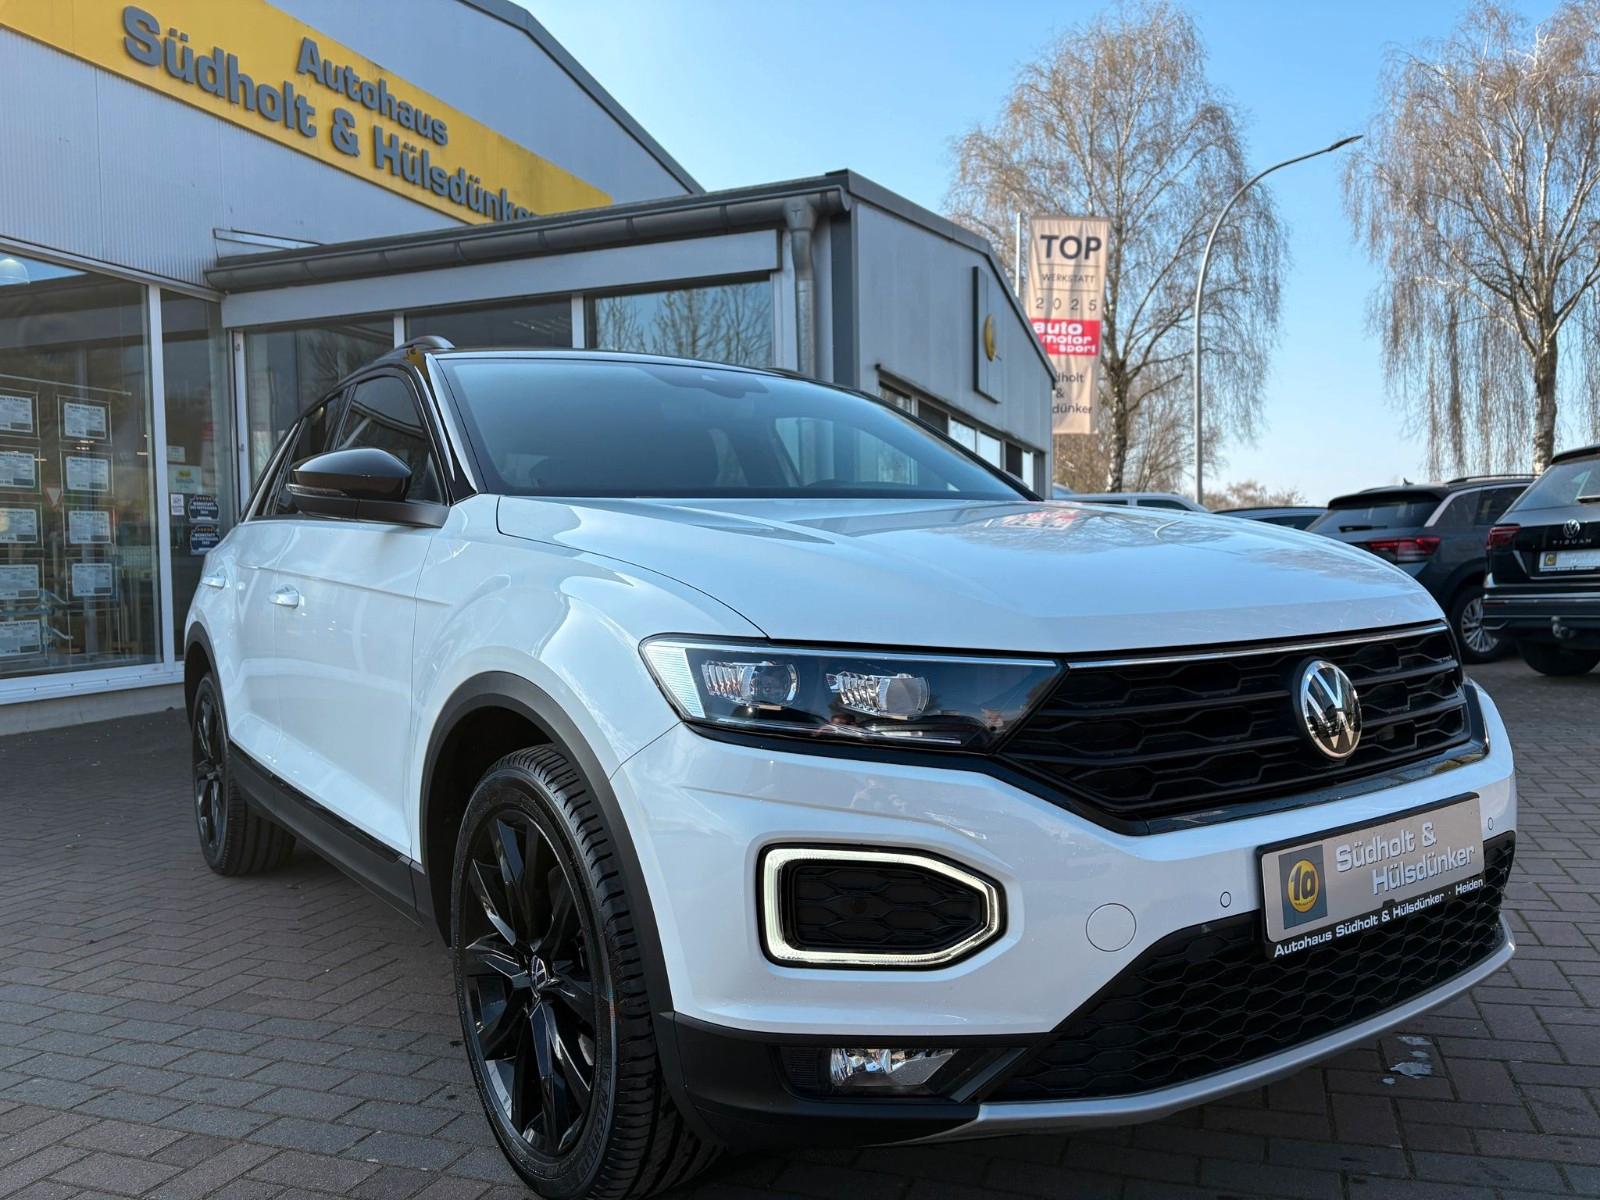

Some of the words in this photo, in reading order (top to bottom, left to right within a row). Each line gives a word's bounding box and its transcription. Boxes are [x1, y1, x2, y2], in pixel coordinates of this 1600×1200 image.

[121, 5, 316, 138] Südholt
[331, 107, 361, 157] &
[296, 37, 449, 146] Autohaus
[1040, 234, 1102, 260] TOP
[1042, 273, 1095, 284] WERKSTATT
[1033, 321, 1083, 336] auto
[1052, 403, 1093, 414] dünker
[1055, 387, 1065, 398] &
[1335, 829, 1416, 873] Südholt
[1421, 821, 1438, 847] &
[1371, 844, 1476, 896] Hülsdünker
[1274, 931, 1333, 958] Autohaus
[1335, 914, 1378, 938] Südholt
[1381, 910, 1391, 922] &
[1392, 892, 1445, 918] Hülsdünker
[1455, 877, 1484, 896] Heiden
